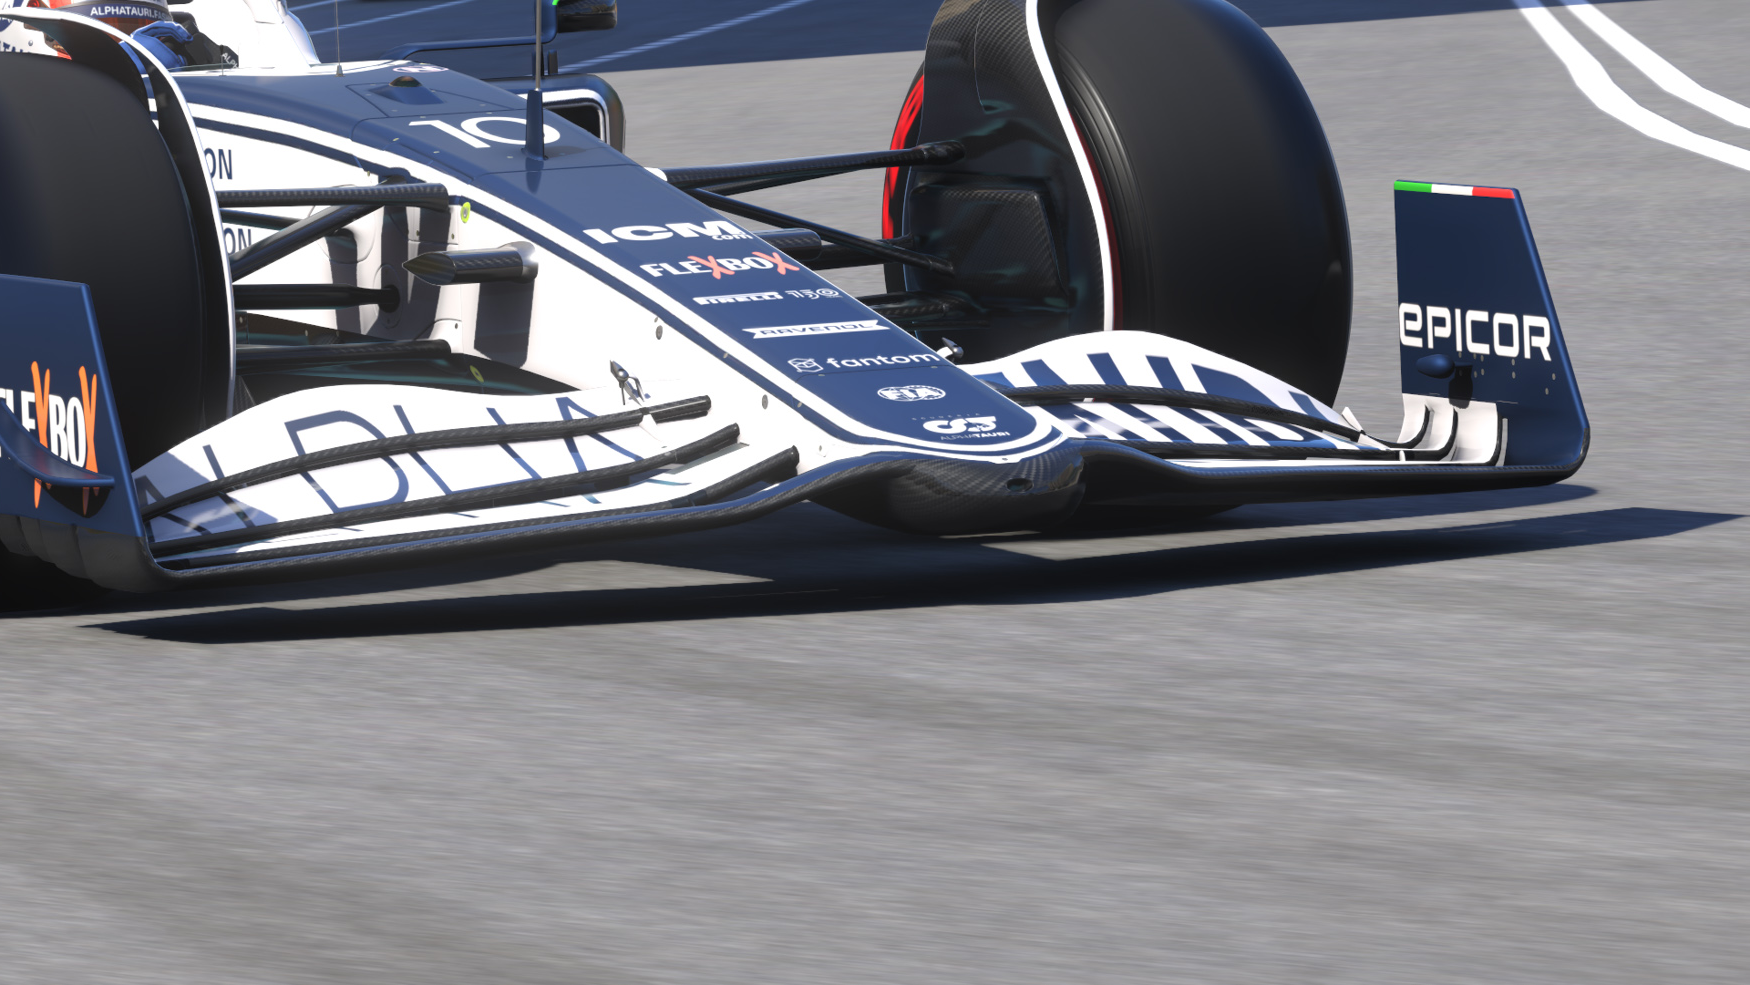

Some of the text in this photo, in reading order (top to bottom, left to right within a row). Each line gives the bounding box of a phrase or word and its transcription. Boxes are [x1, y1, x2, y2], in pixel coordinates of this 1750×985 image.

[408, 116, 561, 149] 10
[583, 220, 747, 245] ICM
[640, 251, 799, 280] FLEXBOX
[692, 291, 784, 306] PIRELLI
[759, 323, 874, 335] RAVENOL
[827, 352, 940, 368] fantom
[880, 388, 942, 400] FIA
